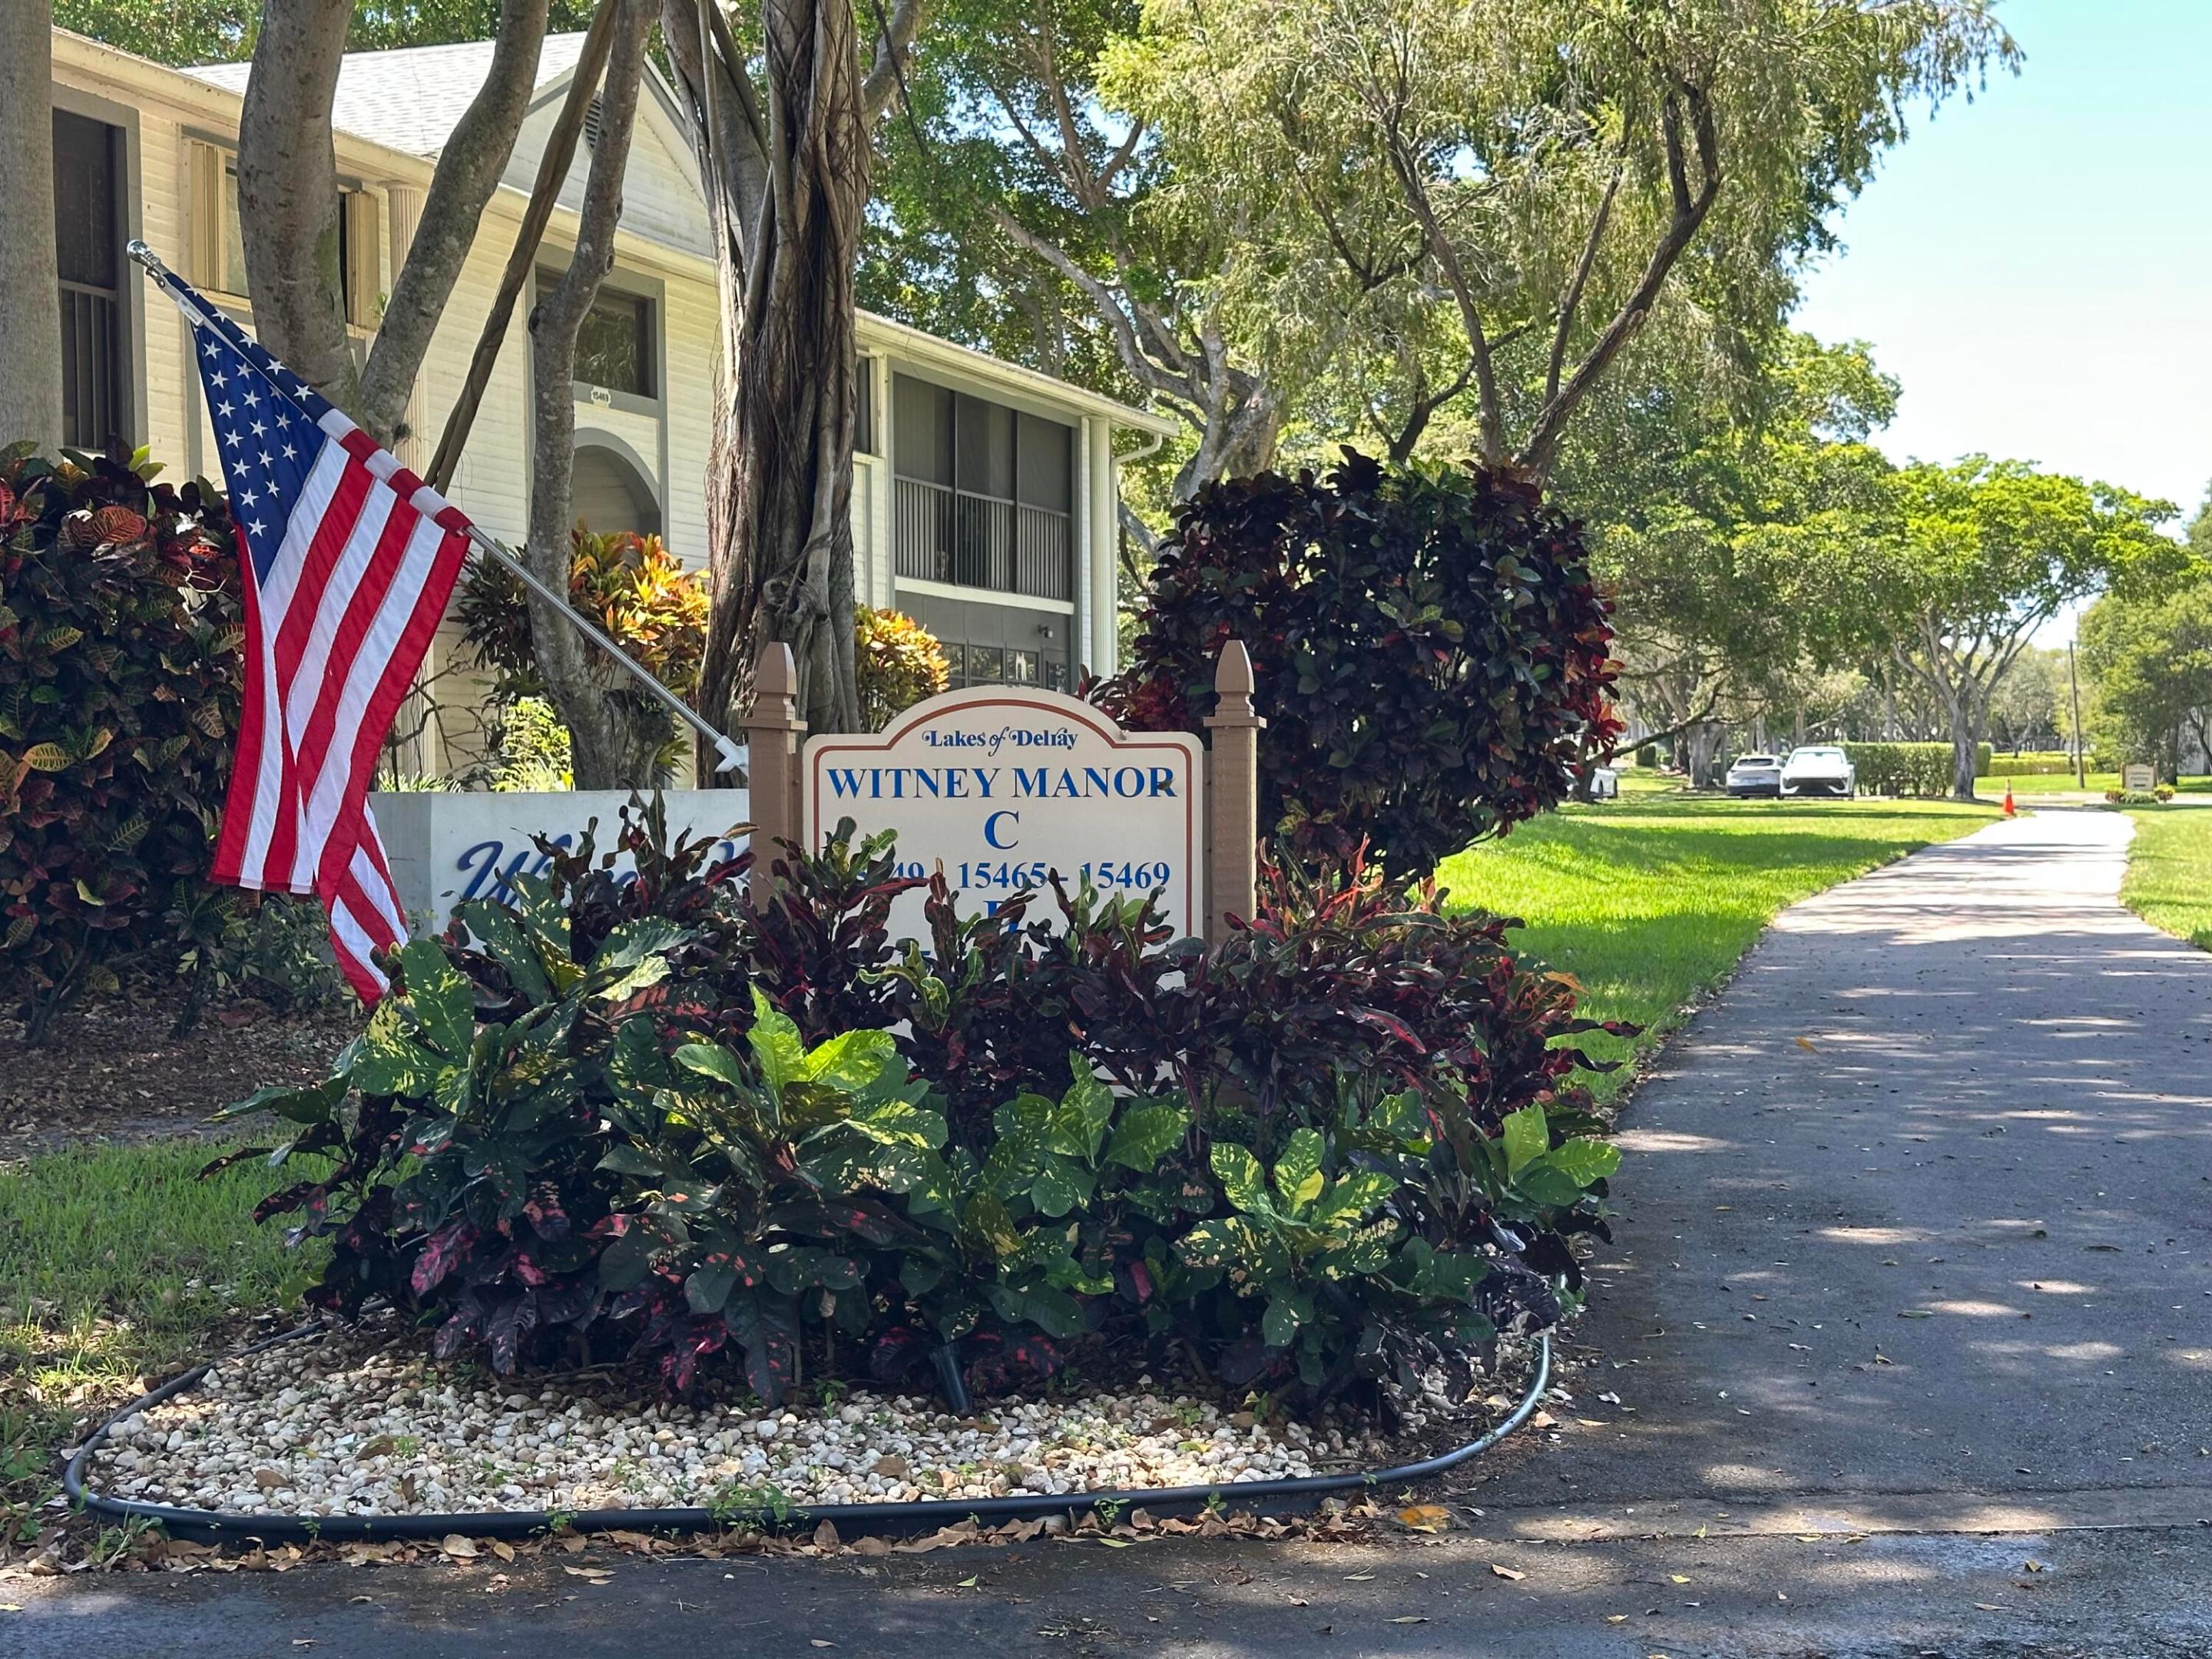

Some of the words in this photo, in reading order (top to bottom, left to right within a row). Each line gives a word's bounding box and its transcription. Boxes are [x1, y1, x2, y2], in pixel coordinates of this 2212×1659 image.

[922, 728, 986, 747] Lakes
[988, 726, 1009, 757] of
[1008, 727, 1078, 750] Delray
[827, 768, 1002, 798] WITNEY
[1012, 767, 1179, 798] MANOR
[983, 810, 1019, 849] C
